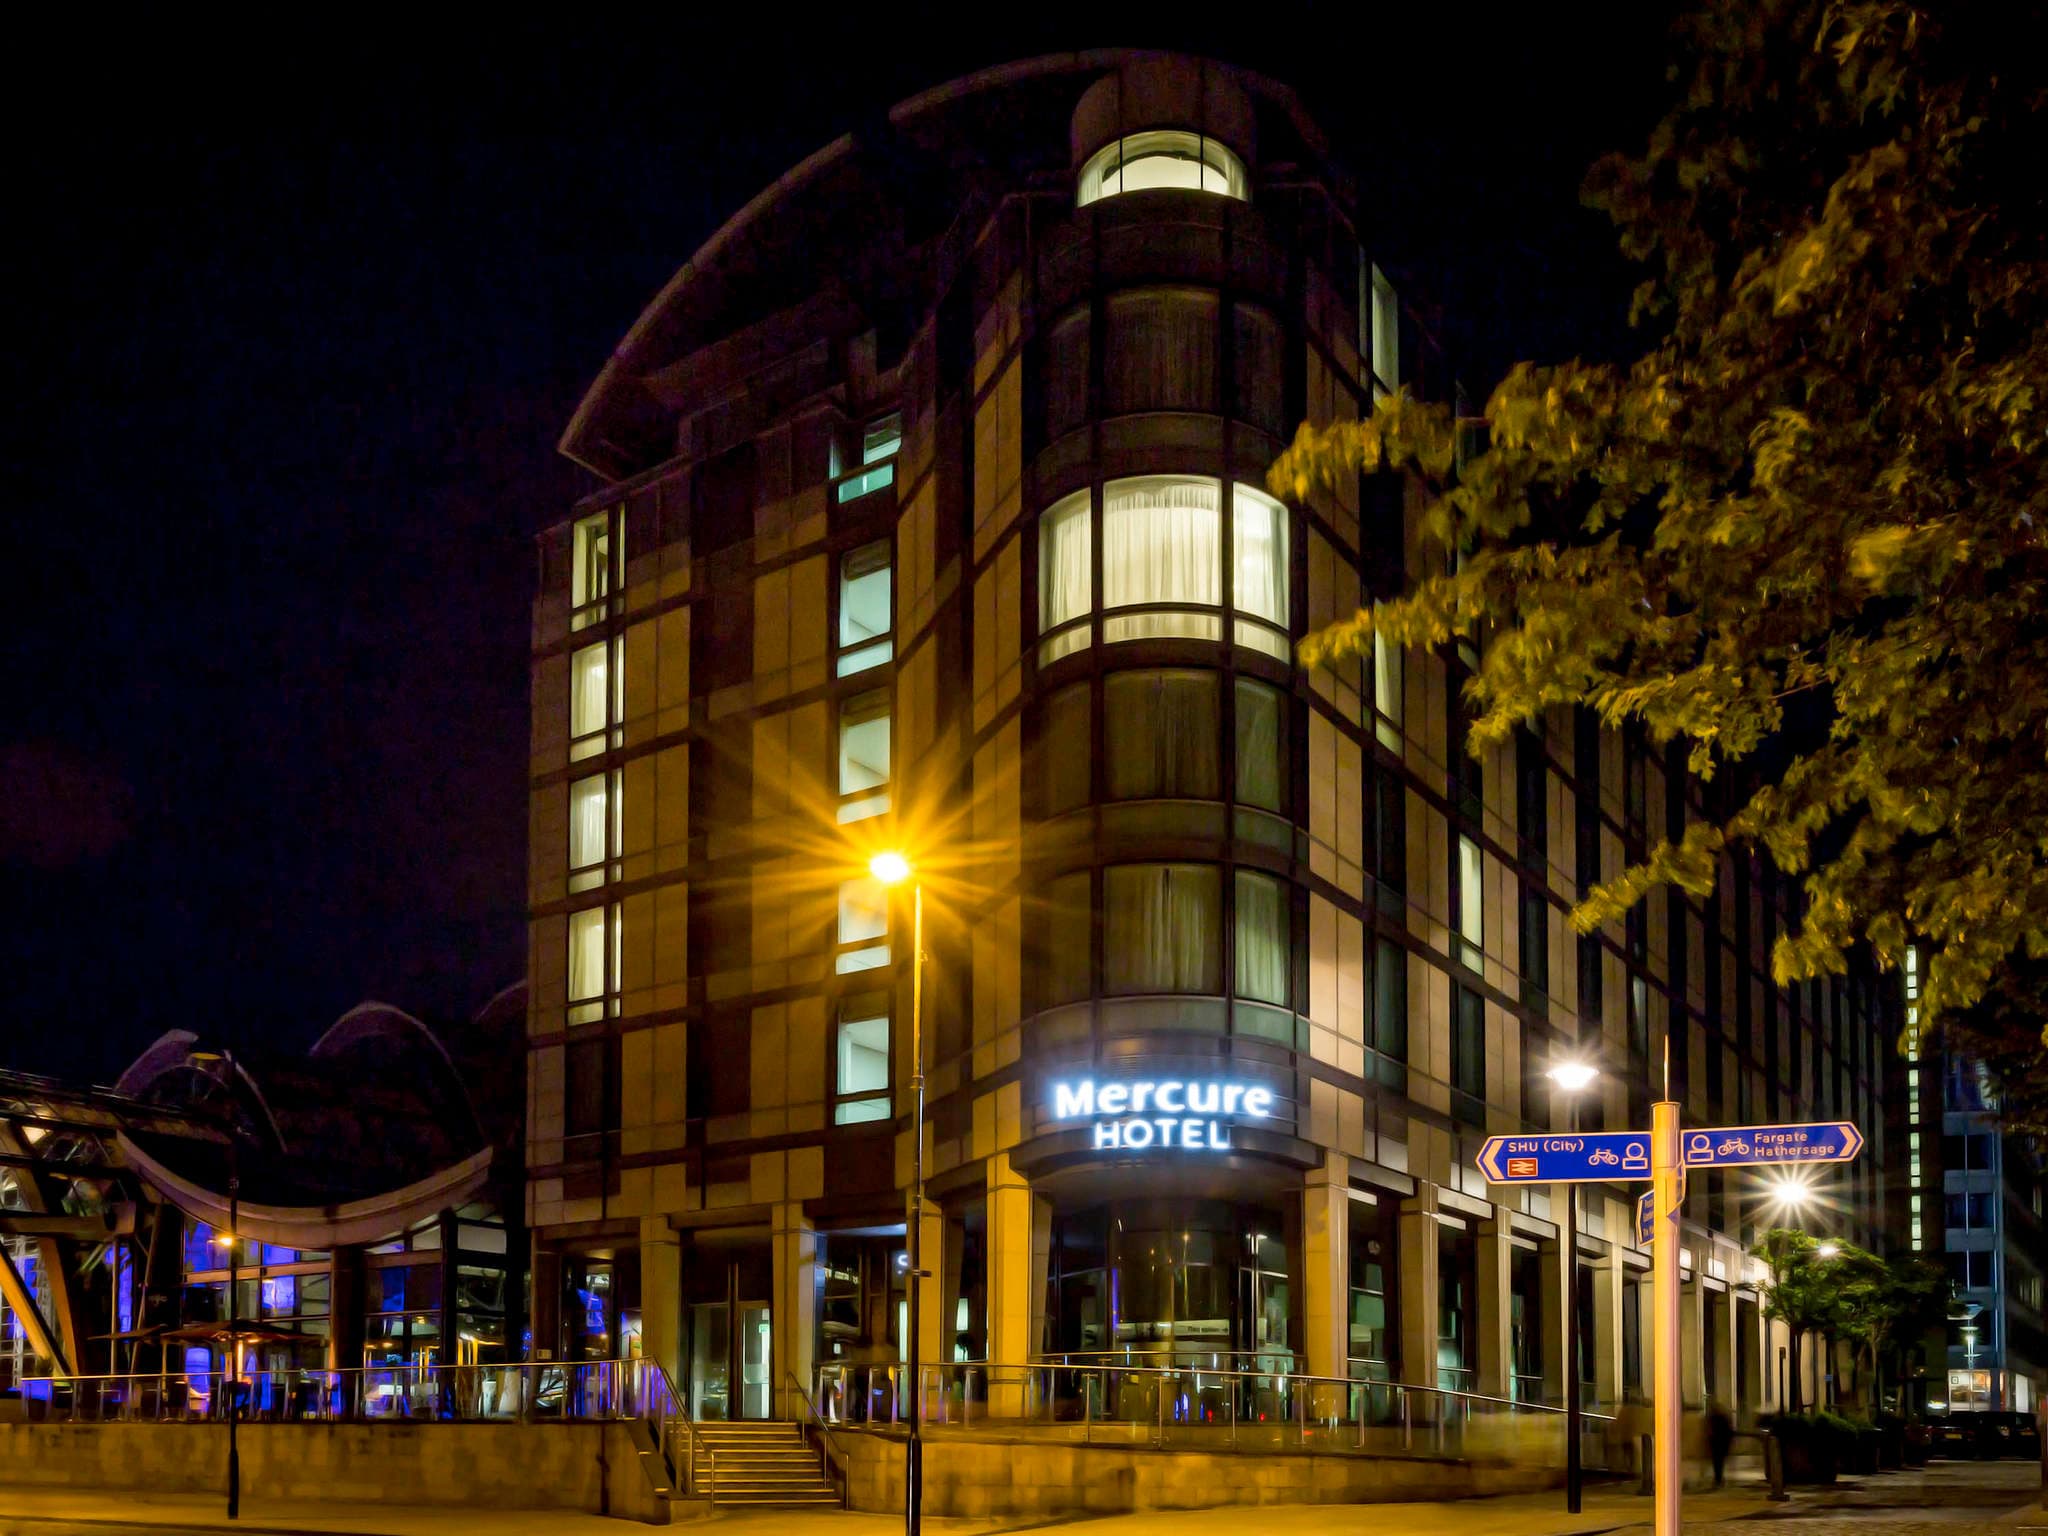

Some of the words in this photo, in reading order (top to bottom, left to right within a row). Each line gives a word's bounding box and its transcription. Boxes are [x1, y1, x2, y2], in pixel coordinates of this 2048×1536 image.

[1055, 1080, 1272, 1118] Mercure
[1094, 1119, 1230, 1150] HOTEL
[1754, 1132, 1808, 1145] Fargate
[1508, 1141, 1538, 1152] SHU
[1543, 1139, 1584, 1152] (City)
[1754, 1144, 1835, 1157] Hathersage
